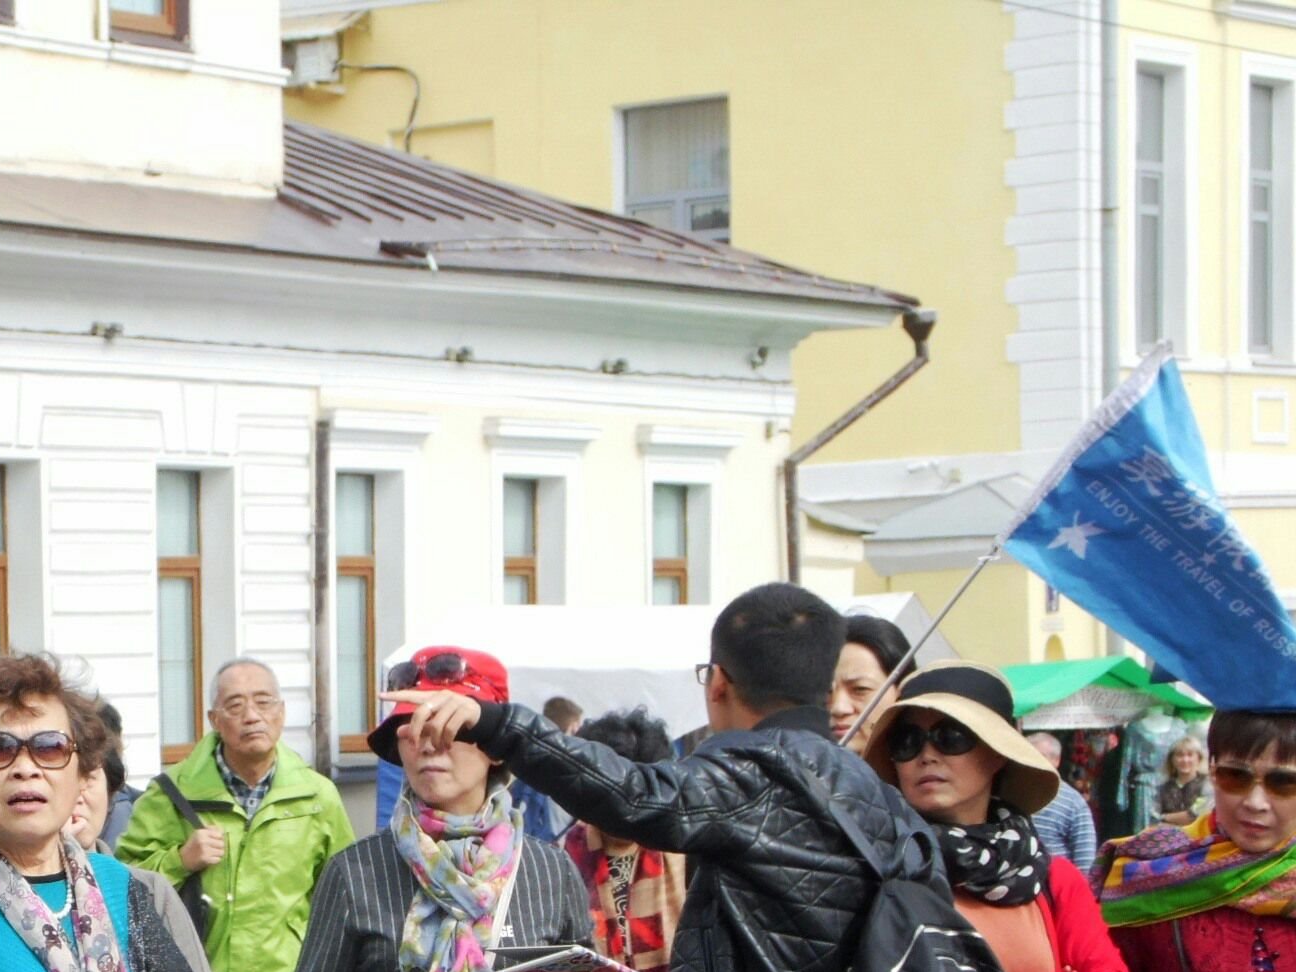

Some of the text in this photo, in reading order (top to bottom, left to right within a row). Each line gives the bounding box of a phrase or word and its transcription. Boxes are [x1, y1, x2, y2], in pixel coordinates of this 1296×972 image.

[1086, 480, 1140, 525] ENJOY
[1138, 523, 1172, 552] THE
[1170, 550, 1228, 601] TRAVEL
[1228, 598, 1256, 619] OF
